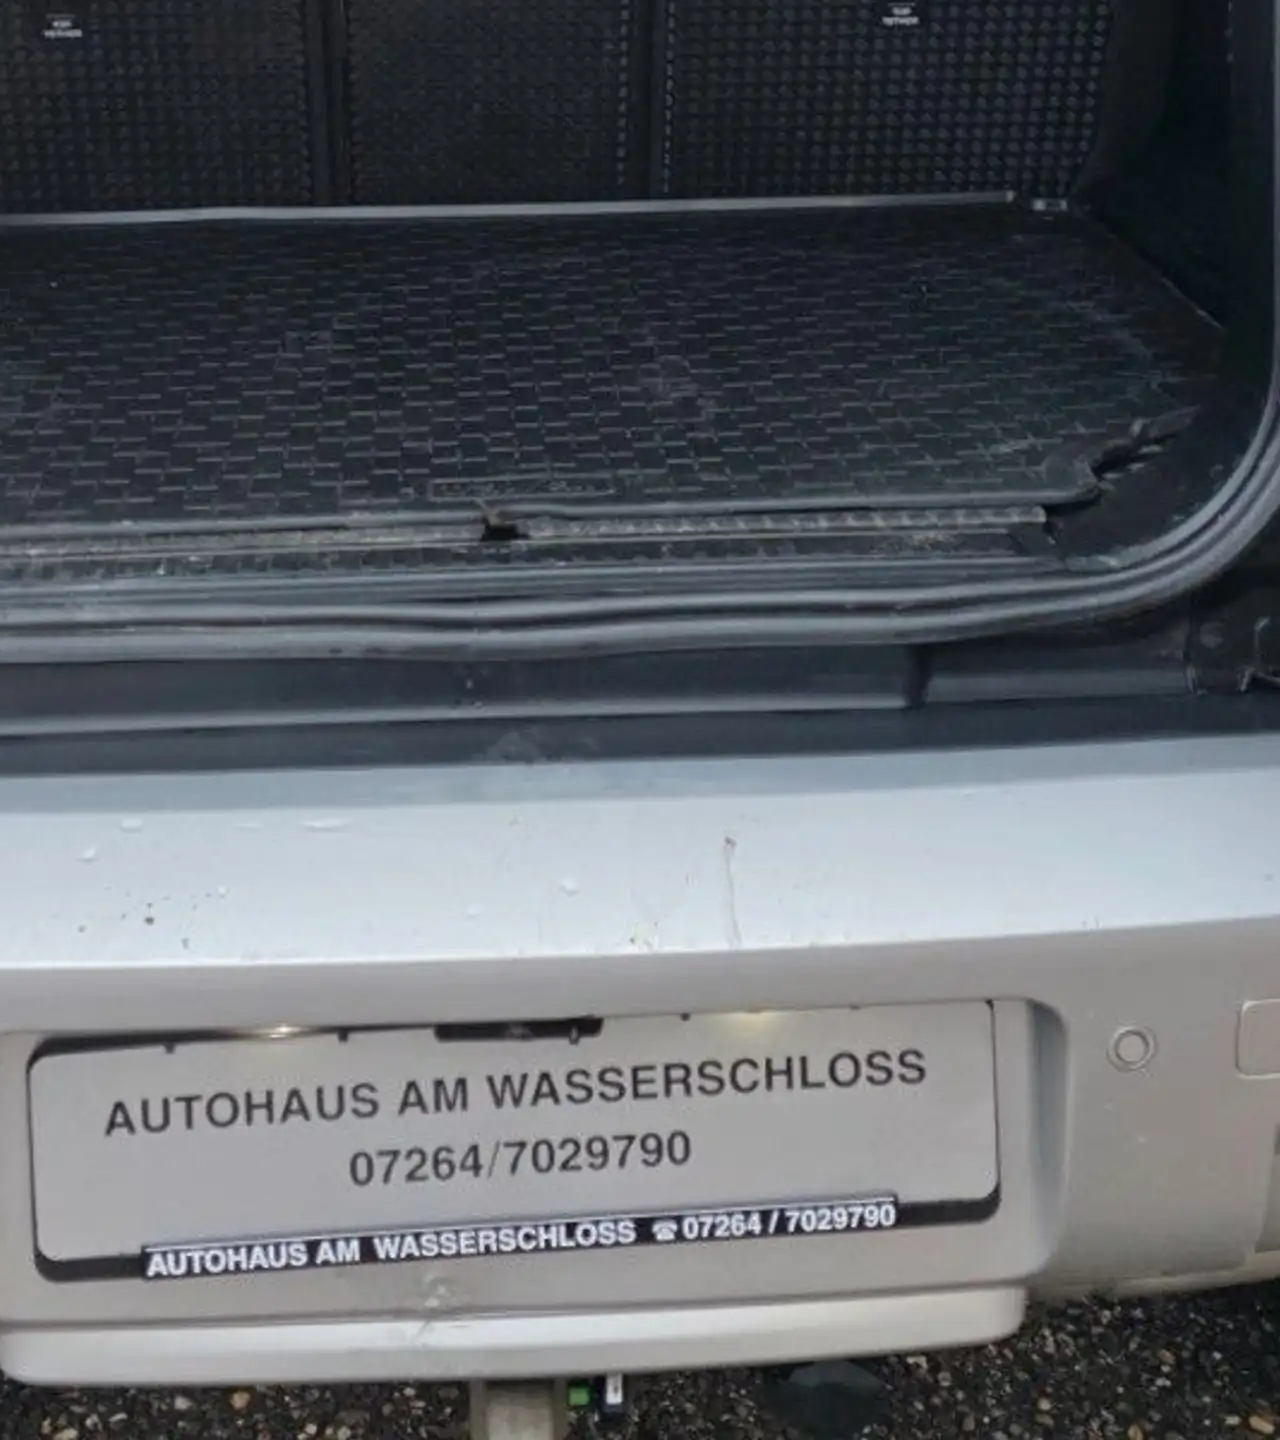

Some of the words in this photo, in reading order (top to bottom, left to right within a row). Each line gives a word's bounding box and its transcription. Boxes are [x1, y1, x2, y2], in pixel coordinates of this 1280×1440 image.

[104, 1081, 380, 1138] AUTOHAUS
[397, 1075, 469, 1116] AM
[486, 1048, 927, 1110] WASSERSCHLOSS
[349, 1129, 692, 1187] 07264/7029790
[145, 1243, 308, 1277] AUTOHAUS
[316, 1238, 361, 1265] AM
[373, 1219, 636, 1261] WASSERSCHLOSS
[682, 1212, 761, 1241] 07264
[785, 1203, 896, 1233] 7029790
